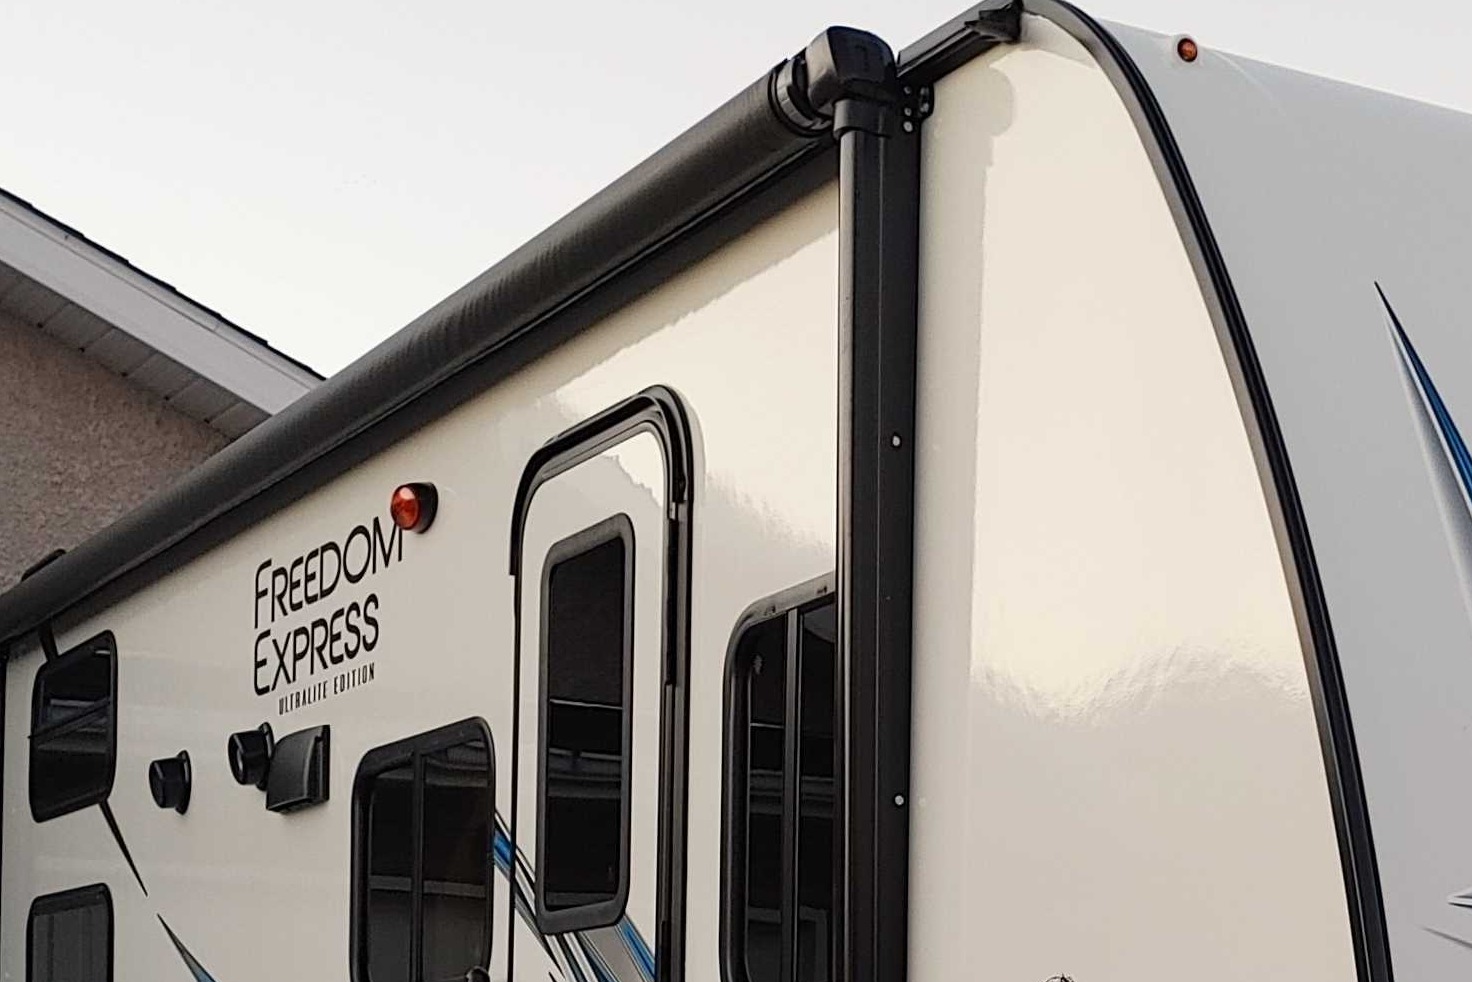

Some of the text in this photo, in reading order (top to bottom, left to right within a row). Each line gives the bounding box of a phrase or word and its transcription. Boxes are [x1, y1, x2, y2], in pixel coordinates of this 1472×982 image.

[254, 516, 403, 629] FREEDOM
[254, 593, 379, 696] EXPRESS
[278, 662, 376, 716] ULTRALITE EDITION
